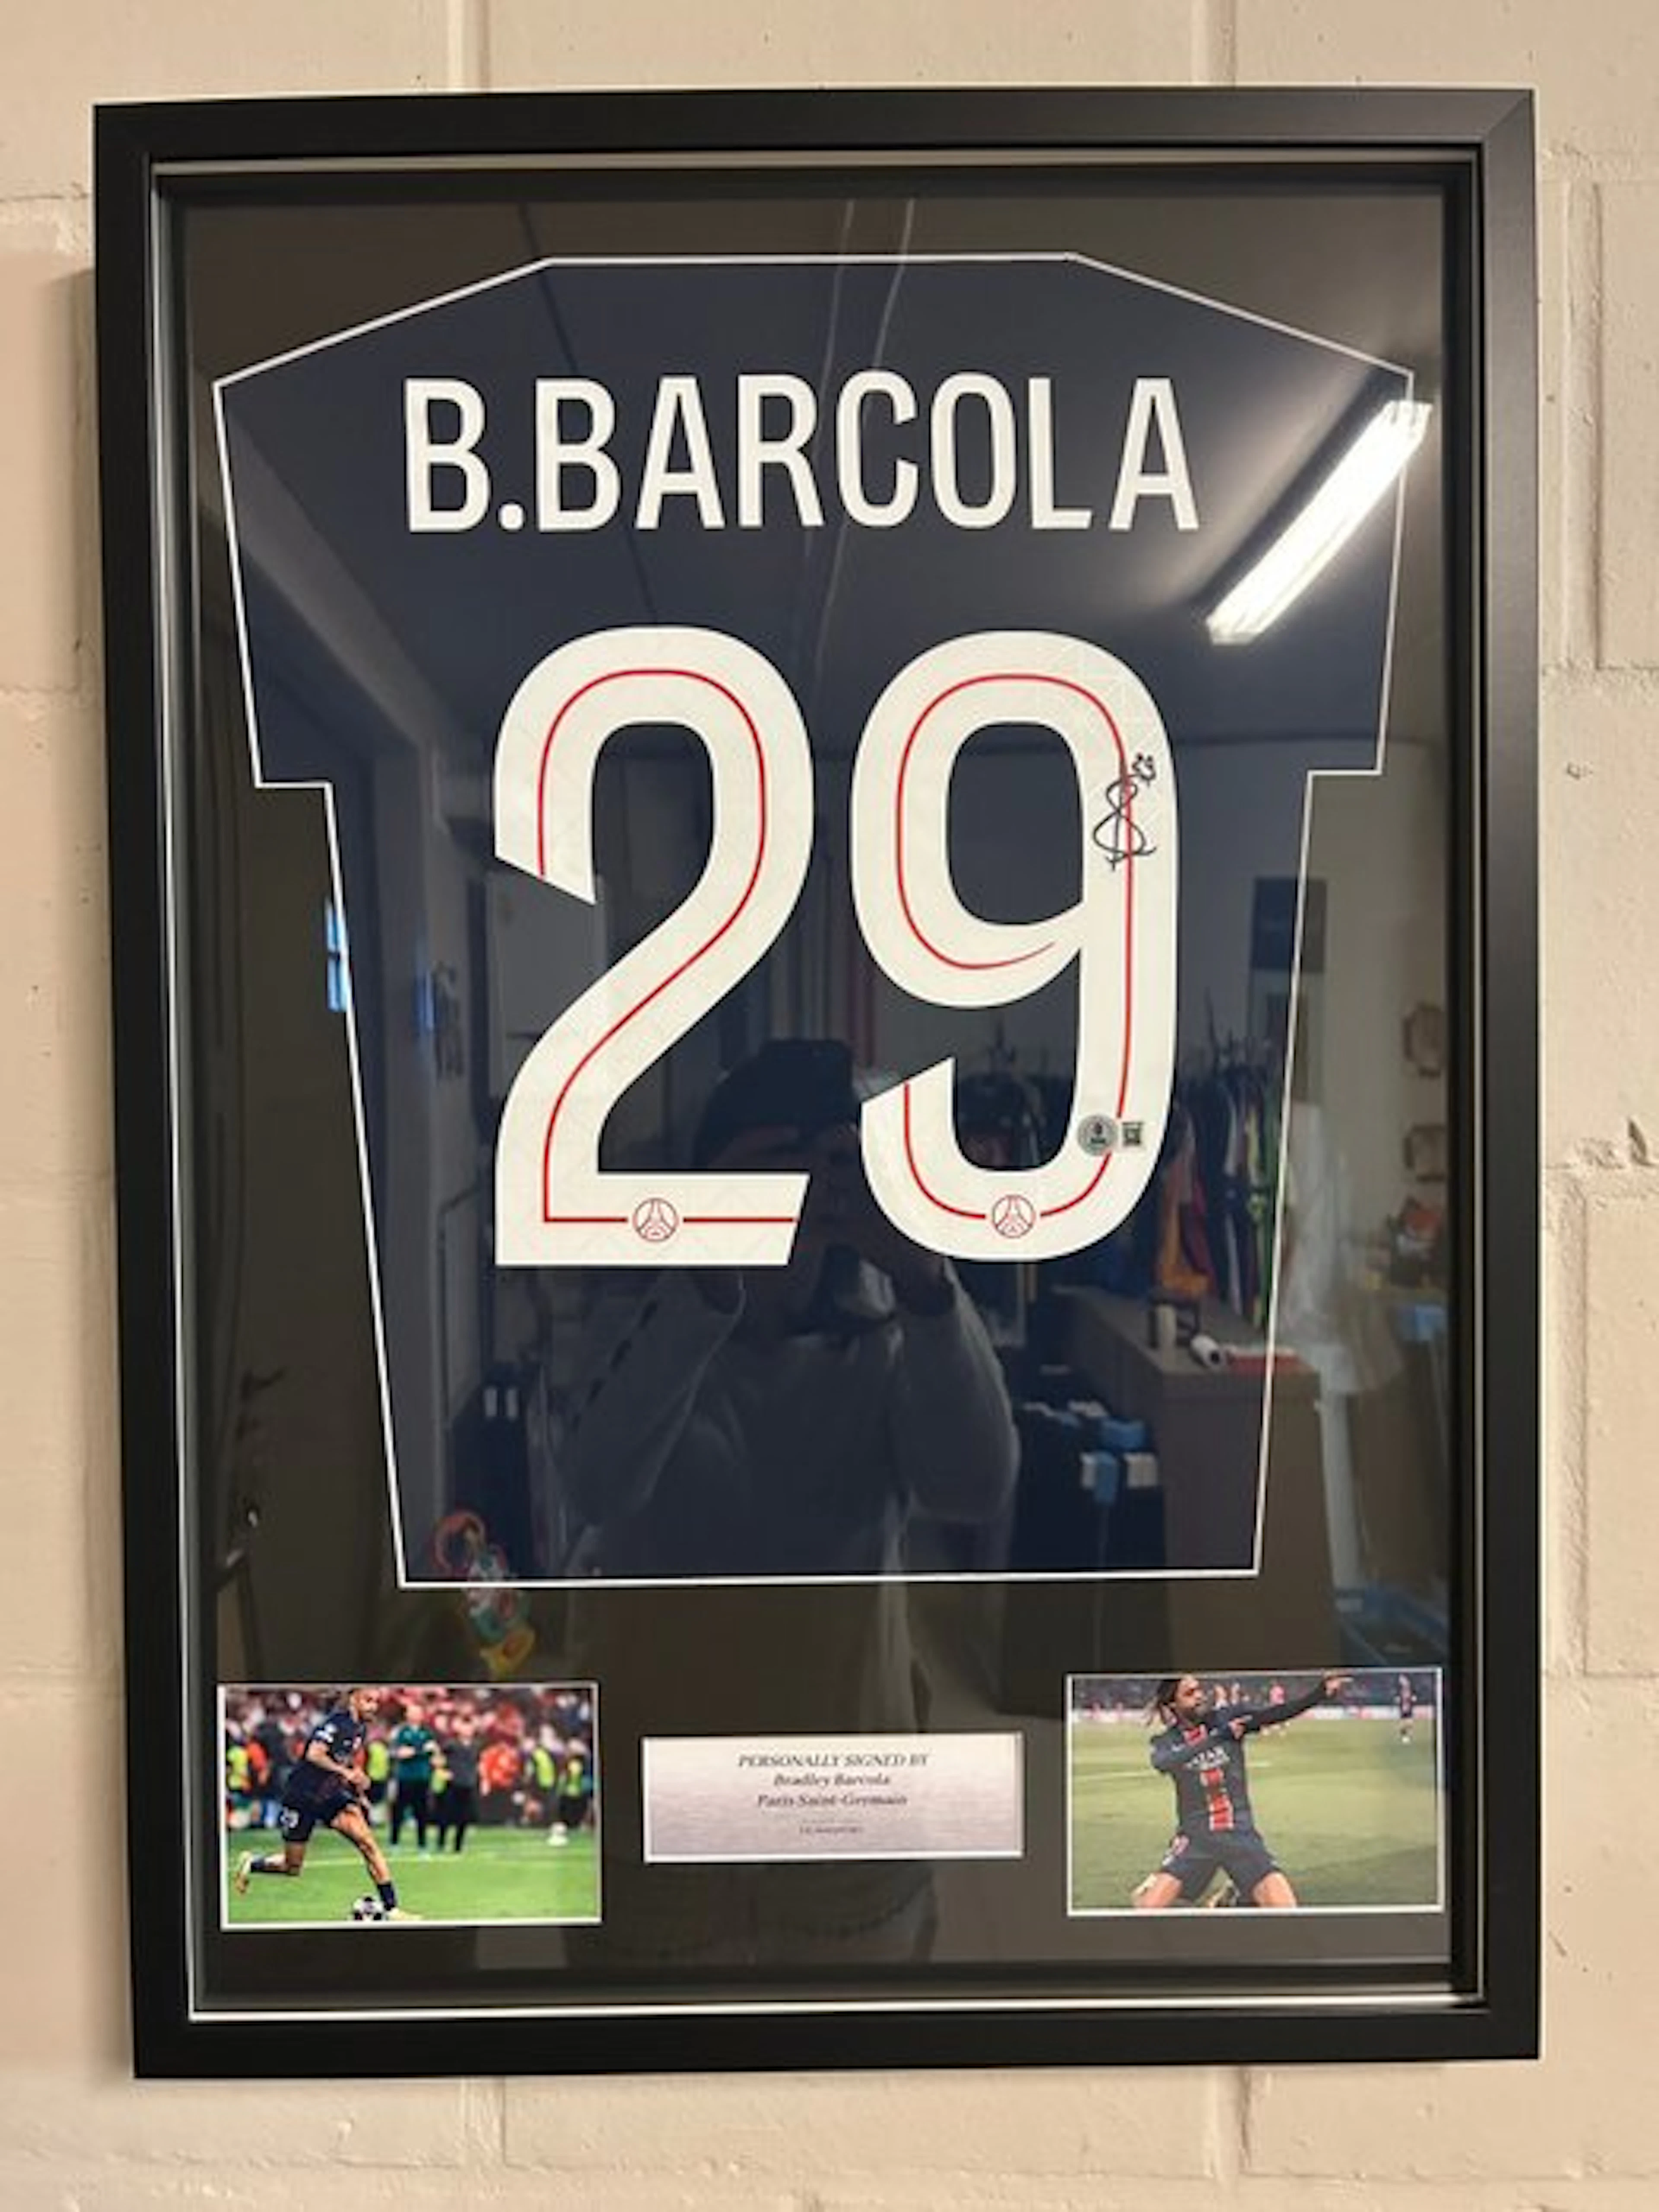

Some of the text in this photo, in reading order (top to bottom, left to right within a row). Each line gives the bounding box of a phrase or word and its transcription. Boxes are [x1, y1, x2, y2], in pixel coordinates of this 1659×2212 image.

[405, 371, 1200, 532] B.BARCOLA
[493, 626, 1178, 1266] 29
[737, 1753, 930, 1767] PERSONALLY SIGNED BY
[773, 1772, 890, 1788] Bradley Barcola
[757, 1793, 908, 1808] Paris Saint-Germain
